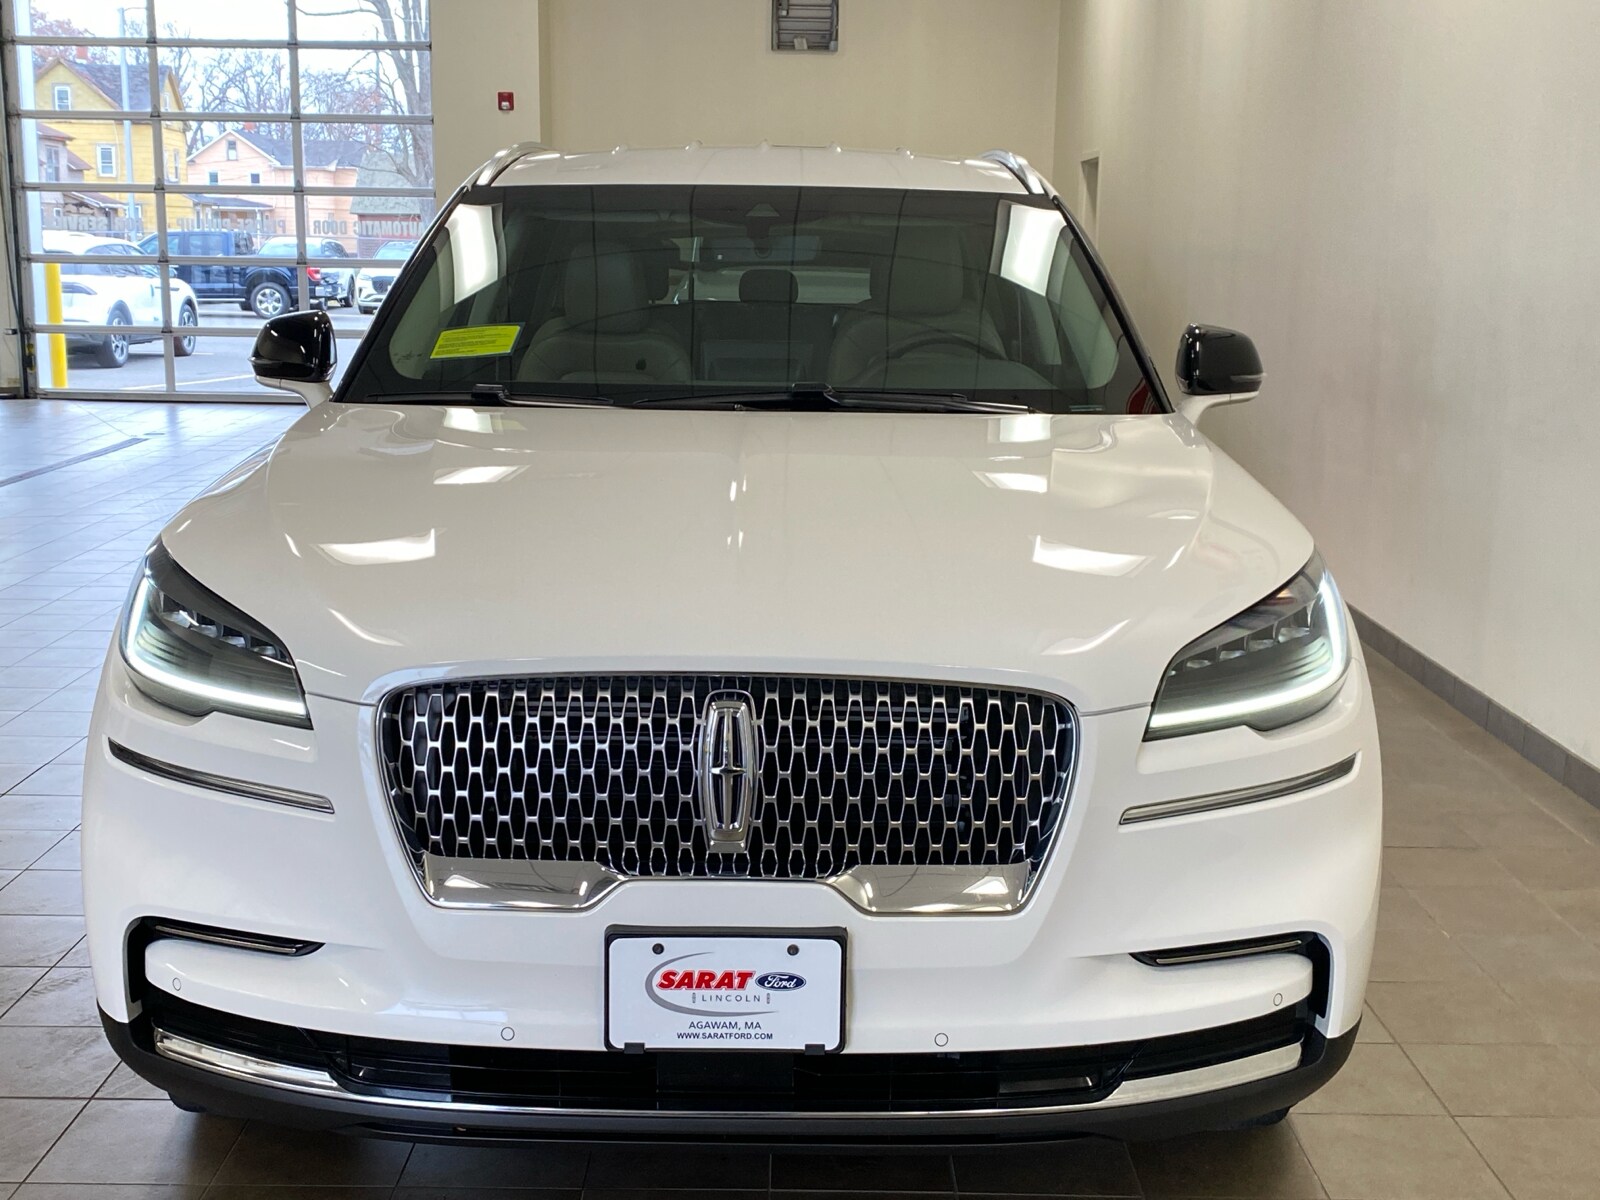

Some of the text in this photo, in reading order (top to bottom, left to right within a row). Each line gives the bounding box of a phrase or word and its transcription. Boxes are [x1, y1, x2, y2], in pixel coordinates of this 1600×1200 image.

[656, 970, 797, 991] SARAT Ford
[701, 994, 761, 1002] LINCOLN
[688, 1021, 762, 1030] AGAWAM, MA
[676, 1032, 773, 1040] WWW.SARATFORD.COM
